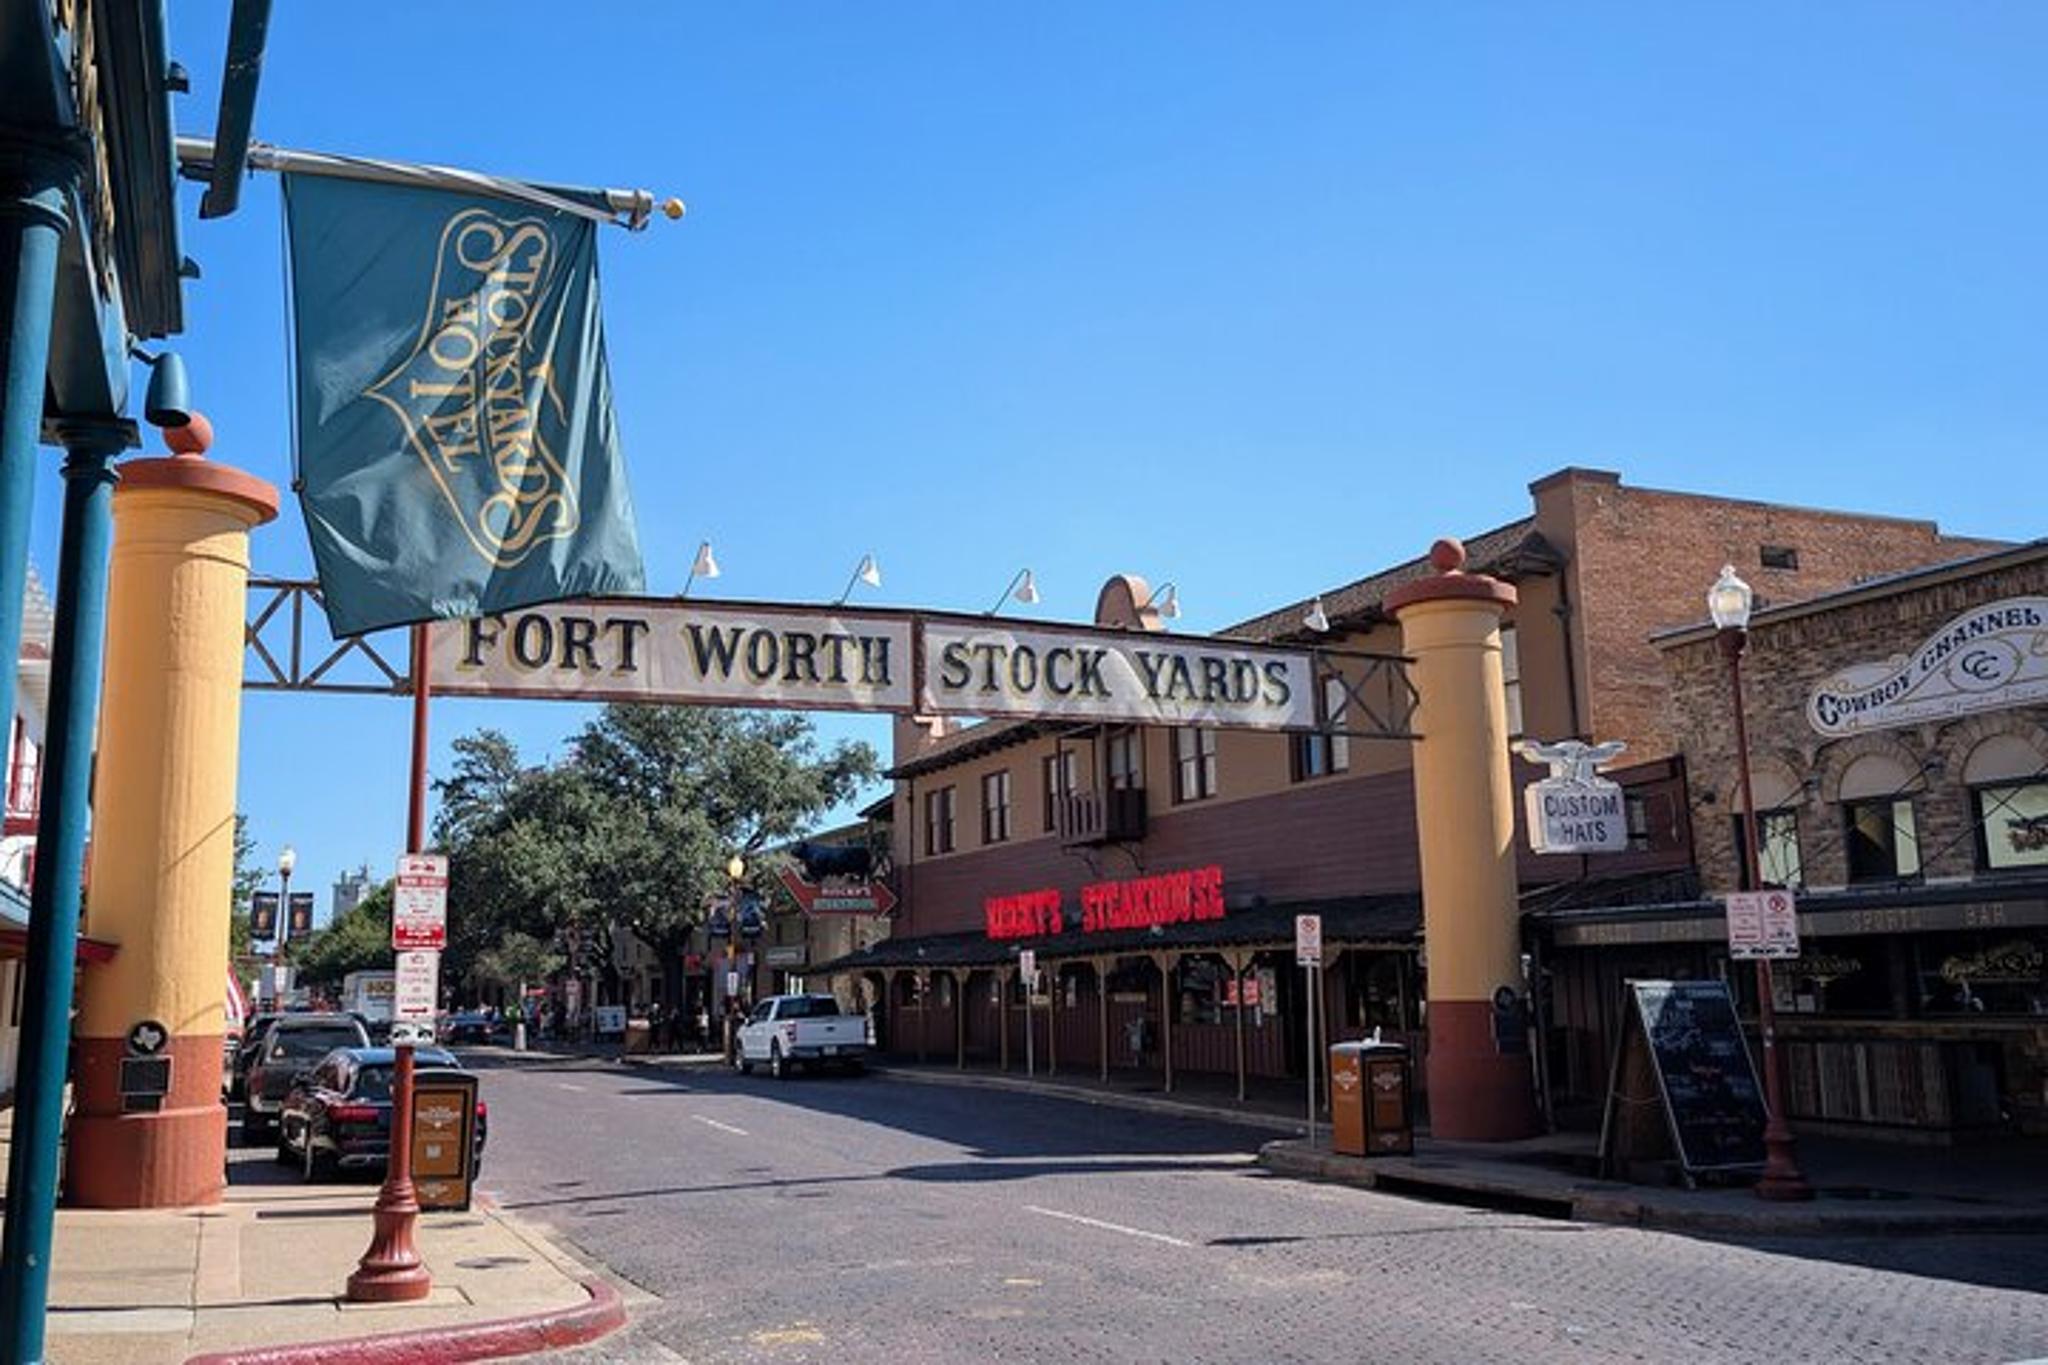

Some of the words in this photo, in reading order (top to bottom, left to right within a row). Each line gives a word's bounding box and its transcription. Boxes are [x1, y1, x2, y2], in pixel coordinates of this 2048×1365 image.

[411, 296, 481, 474] HOTEL
[457, 222, 575, 553] STOCKYARDS
[460, 612, 650, 673] FORT
[684, 621, 893, 687] WORTH
[941, 640, 1112, 698] STOCK
[1134, 648, 1291, 707] YARDS
[1919, 607, 2041, 672] CHANNEL
[1543, 794, 1619, 818] CUSTOM
[1560, 819, 1608, 843] HATS
[1081, 863, 1226, 934] STEAKHOUSE
